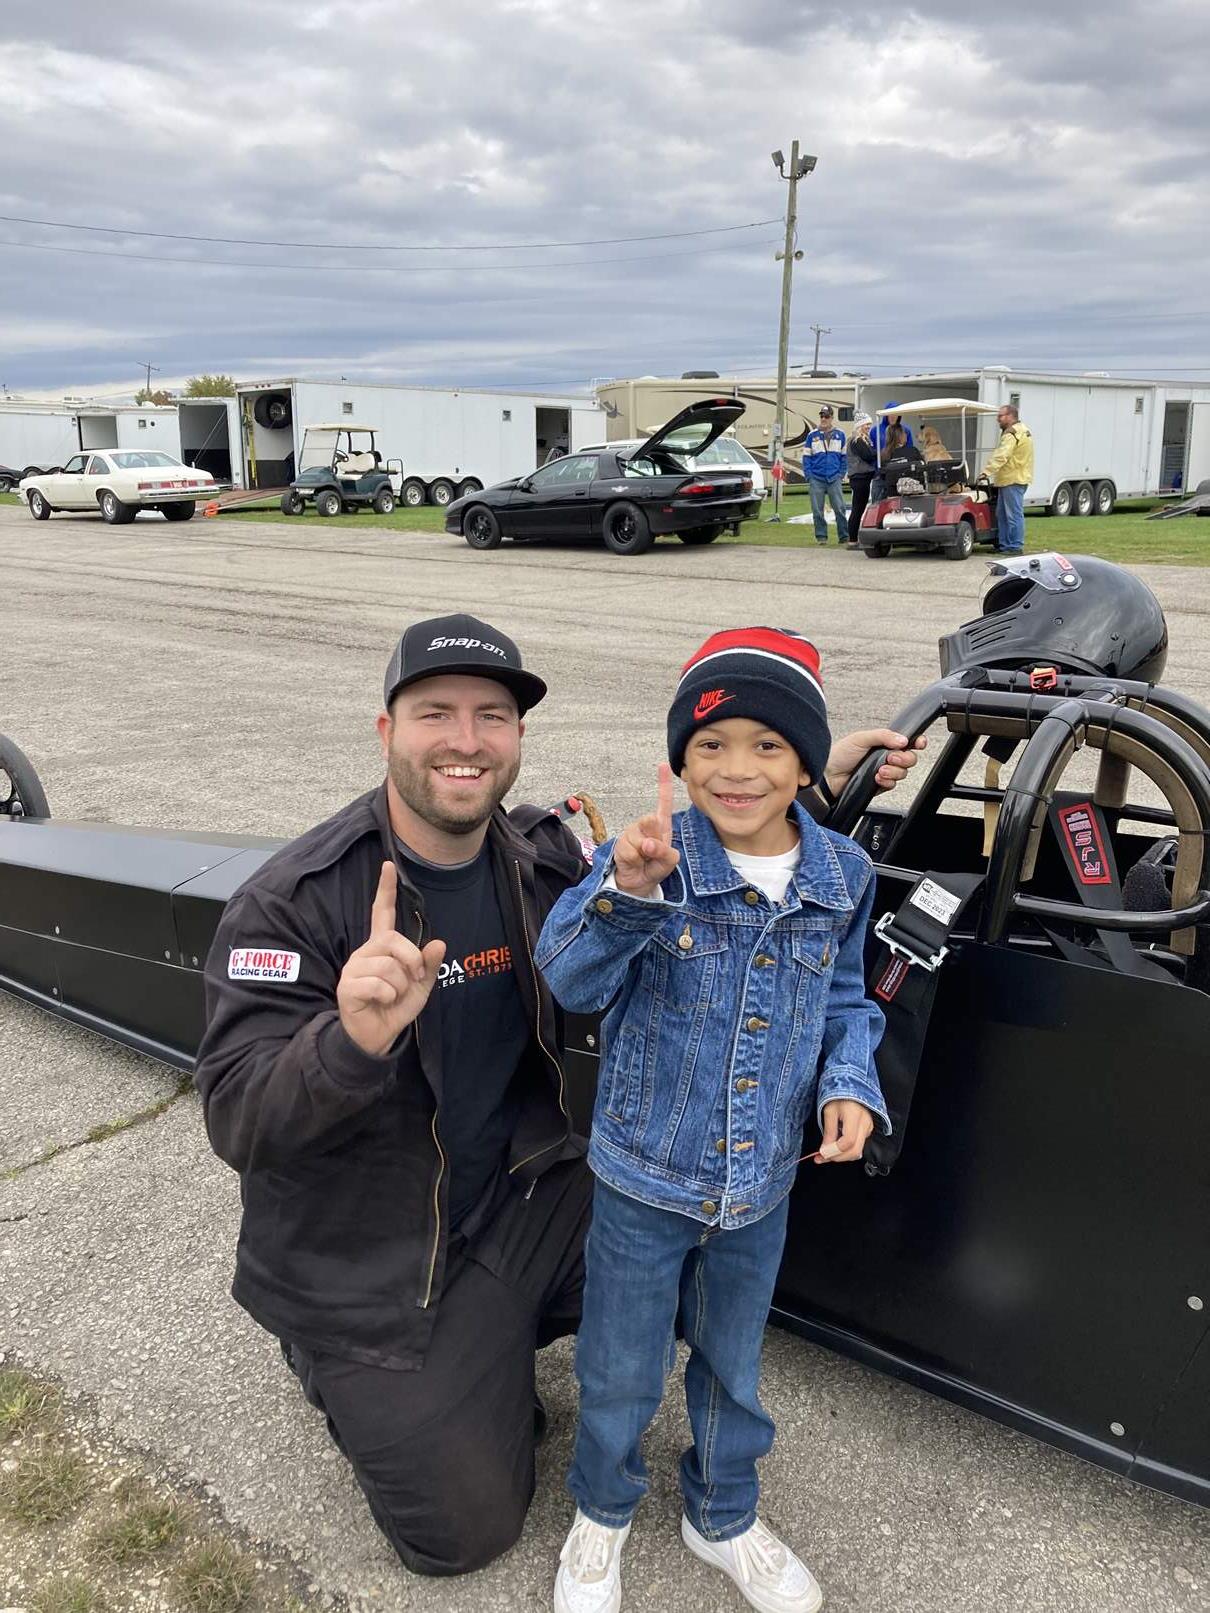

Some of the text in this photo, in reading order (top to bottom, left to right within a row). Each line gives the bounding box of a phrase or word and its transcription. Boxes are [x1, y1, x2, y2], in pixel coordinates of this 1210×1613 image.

[699, 689, 726, 709] NIKE
[919, 896, 933, 907] DEC
[231, 968, 288, 979] RACING GEAR
